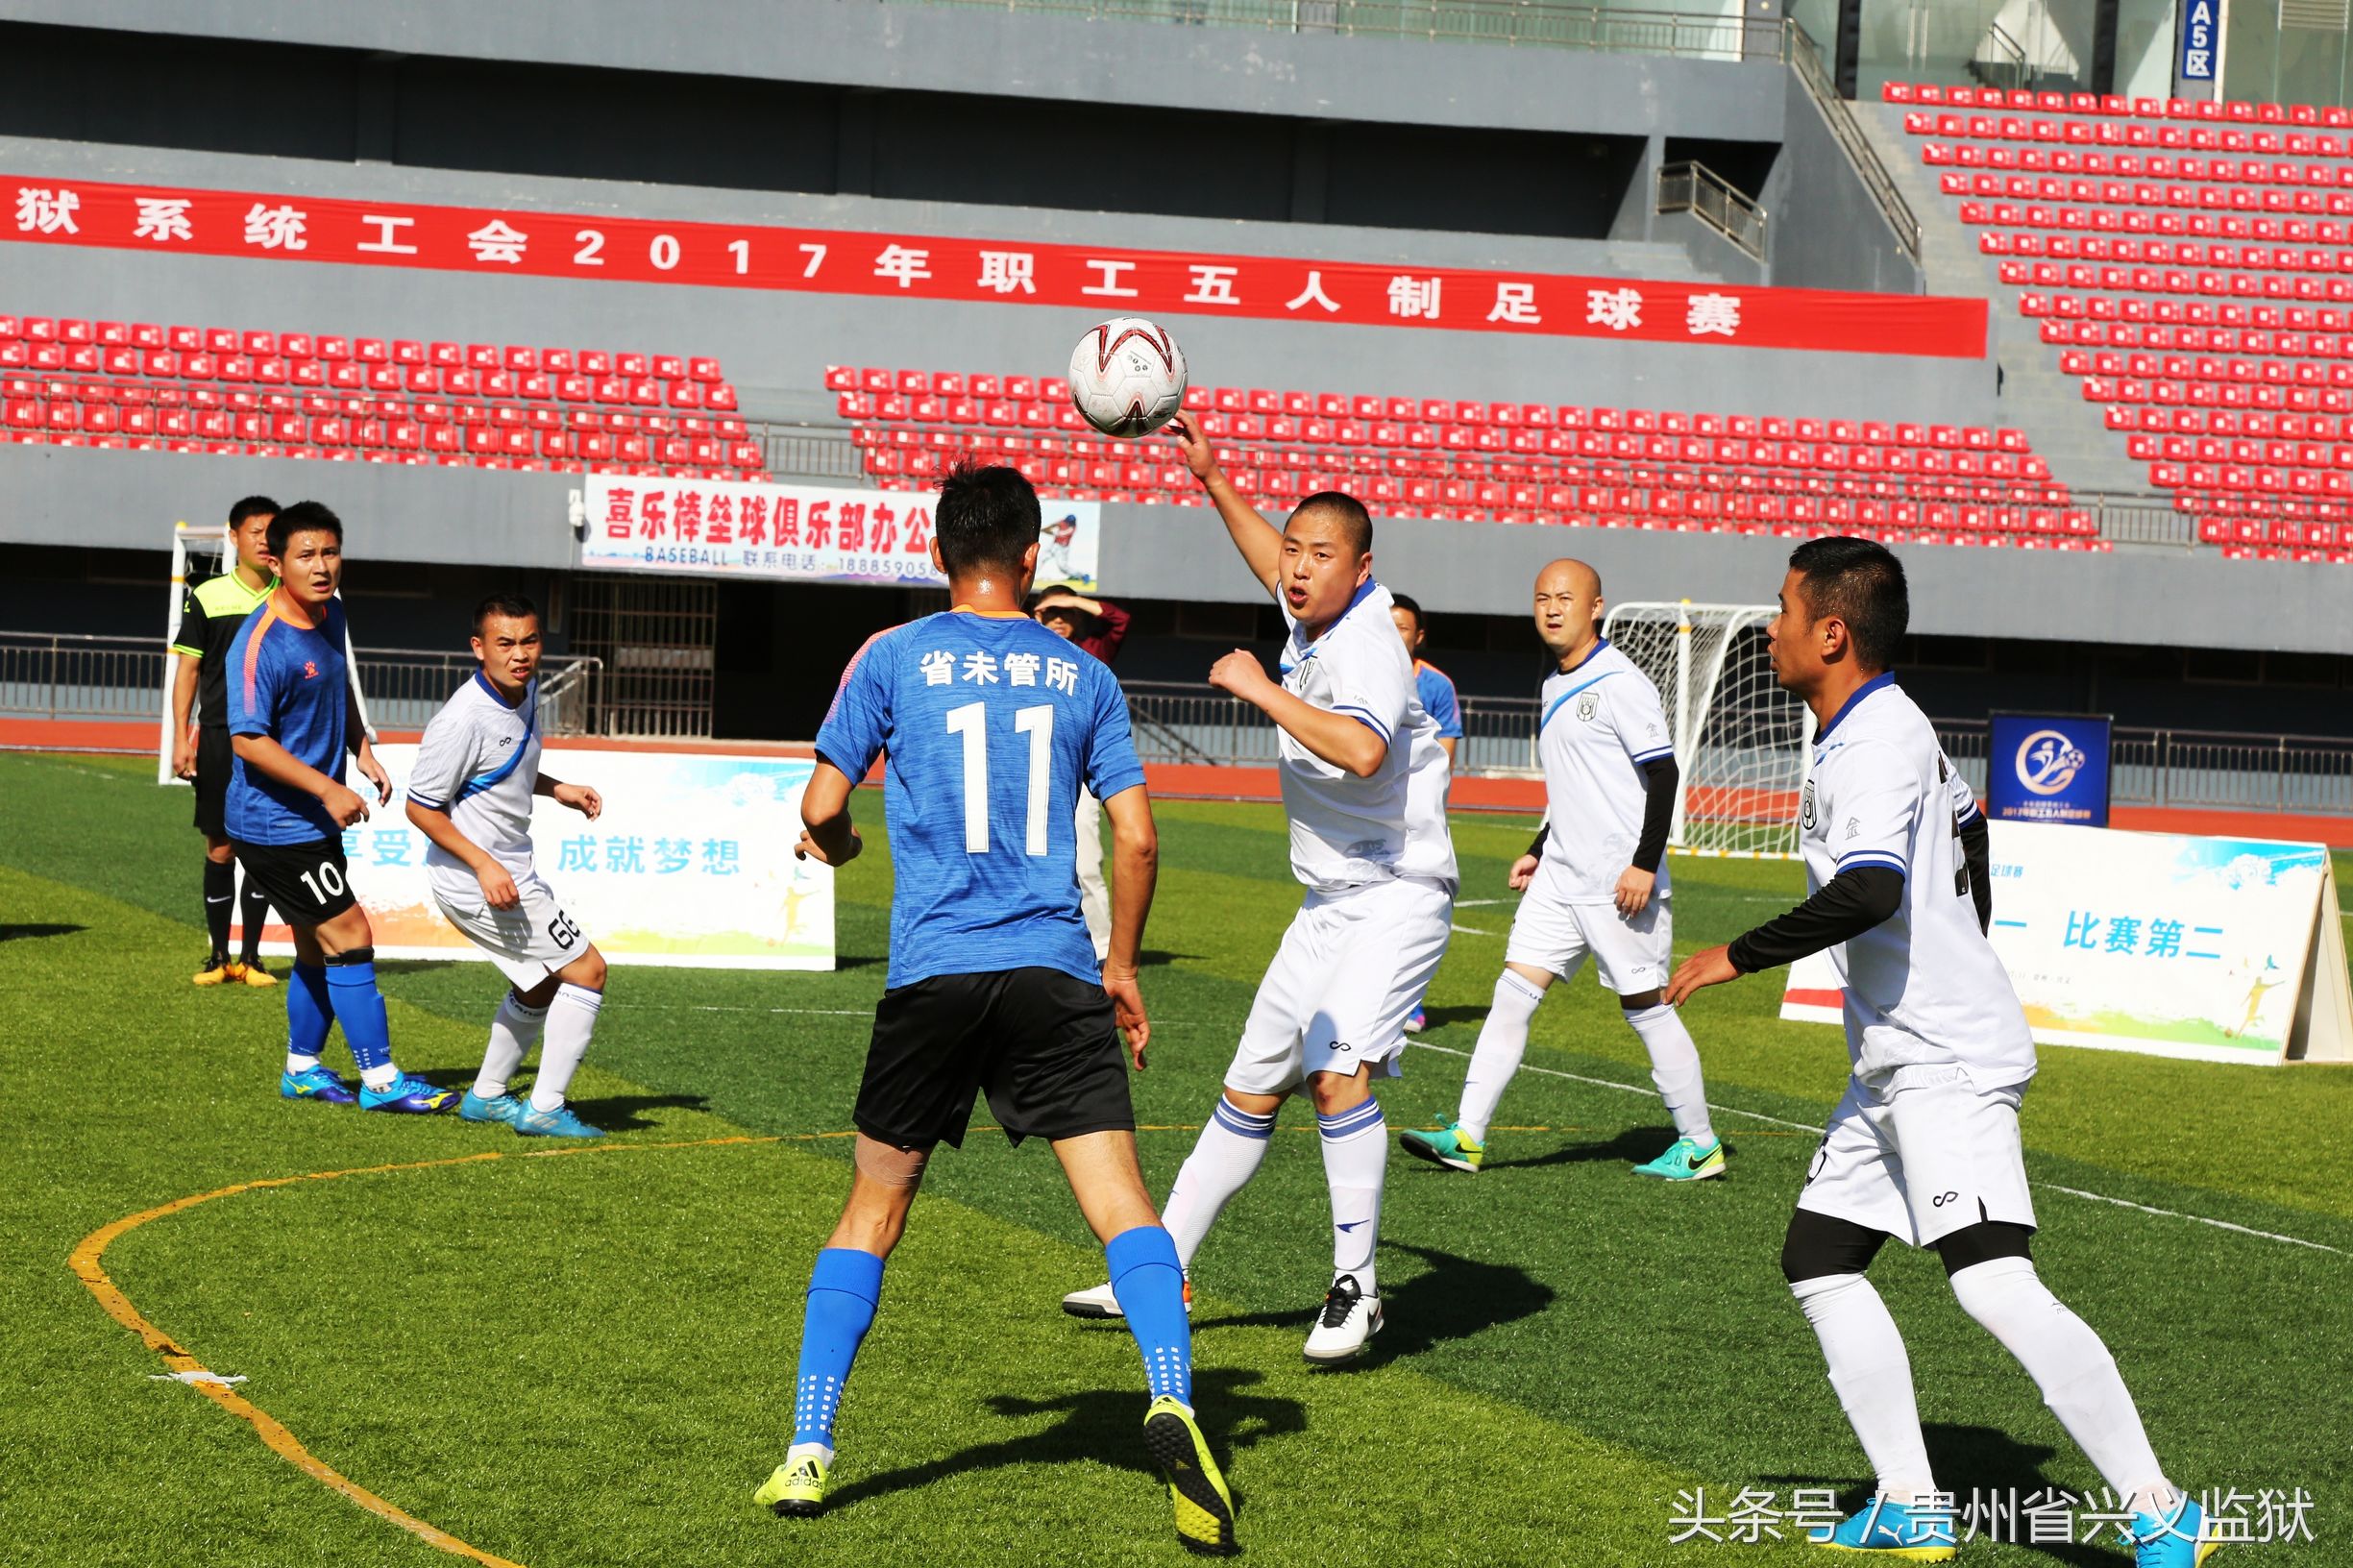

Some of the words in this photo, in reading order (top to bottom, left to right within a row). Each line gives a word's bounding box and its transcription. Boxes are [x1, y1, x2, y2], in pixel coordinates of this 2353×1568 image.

[2186, 1, 2212, 76] A5区
[14, 186, 1741, 337] 狱系统工会2017年职工五人制足球赛
[645, 546, 727, 566] BASEBALL
[919, 650, 1078, 696] 省未管所
[946, 701, 1053, 856] 11
[557, 834, 740, 875] 成就梦想
[300, 861, 344, 905] 10
[2063, 910, 2224, 960] 比赛第二
[785, 1476, 823, 1490] adidas
